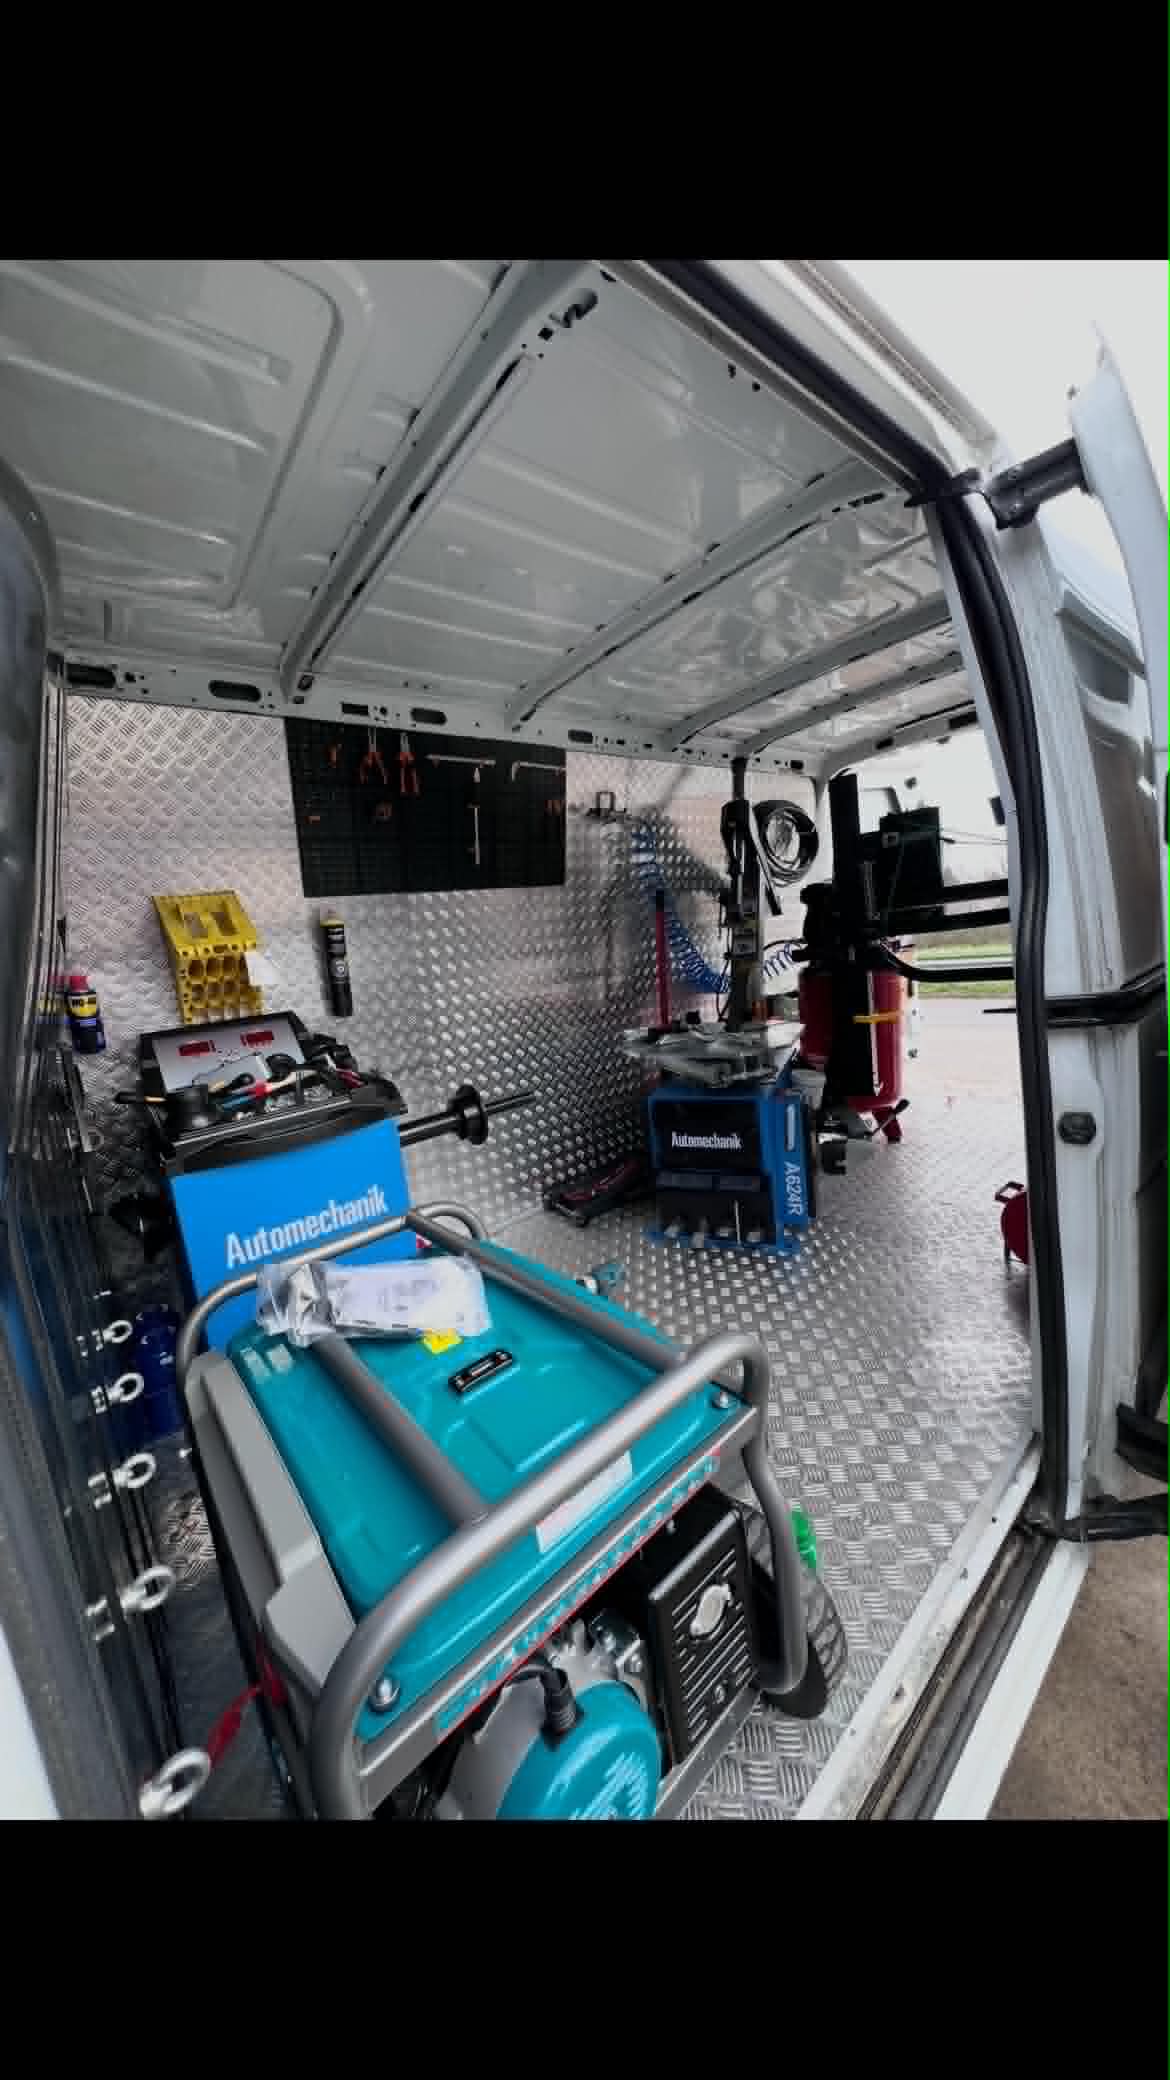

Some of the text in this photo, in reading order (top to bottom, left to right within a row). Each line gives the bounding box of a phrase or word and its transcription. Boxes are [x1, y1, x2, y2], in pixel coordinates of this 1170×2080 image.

[671, 1131, 743, 1150] Automechanik
[784, 1161, 806, 1217] A624R
[225, 1185, 387, 1269] Automechanik
